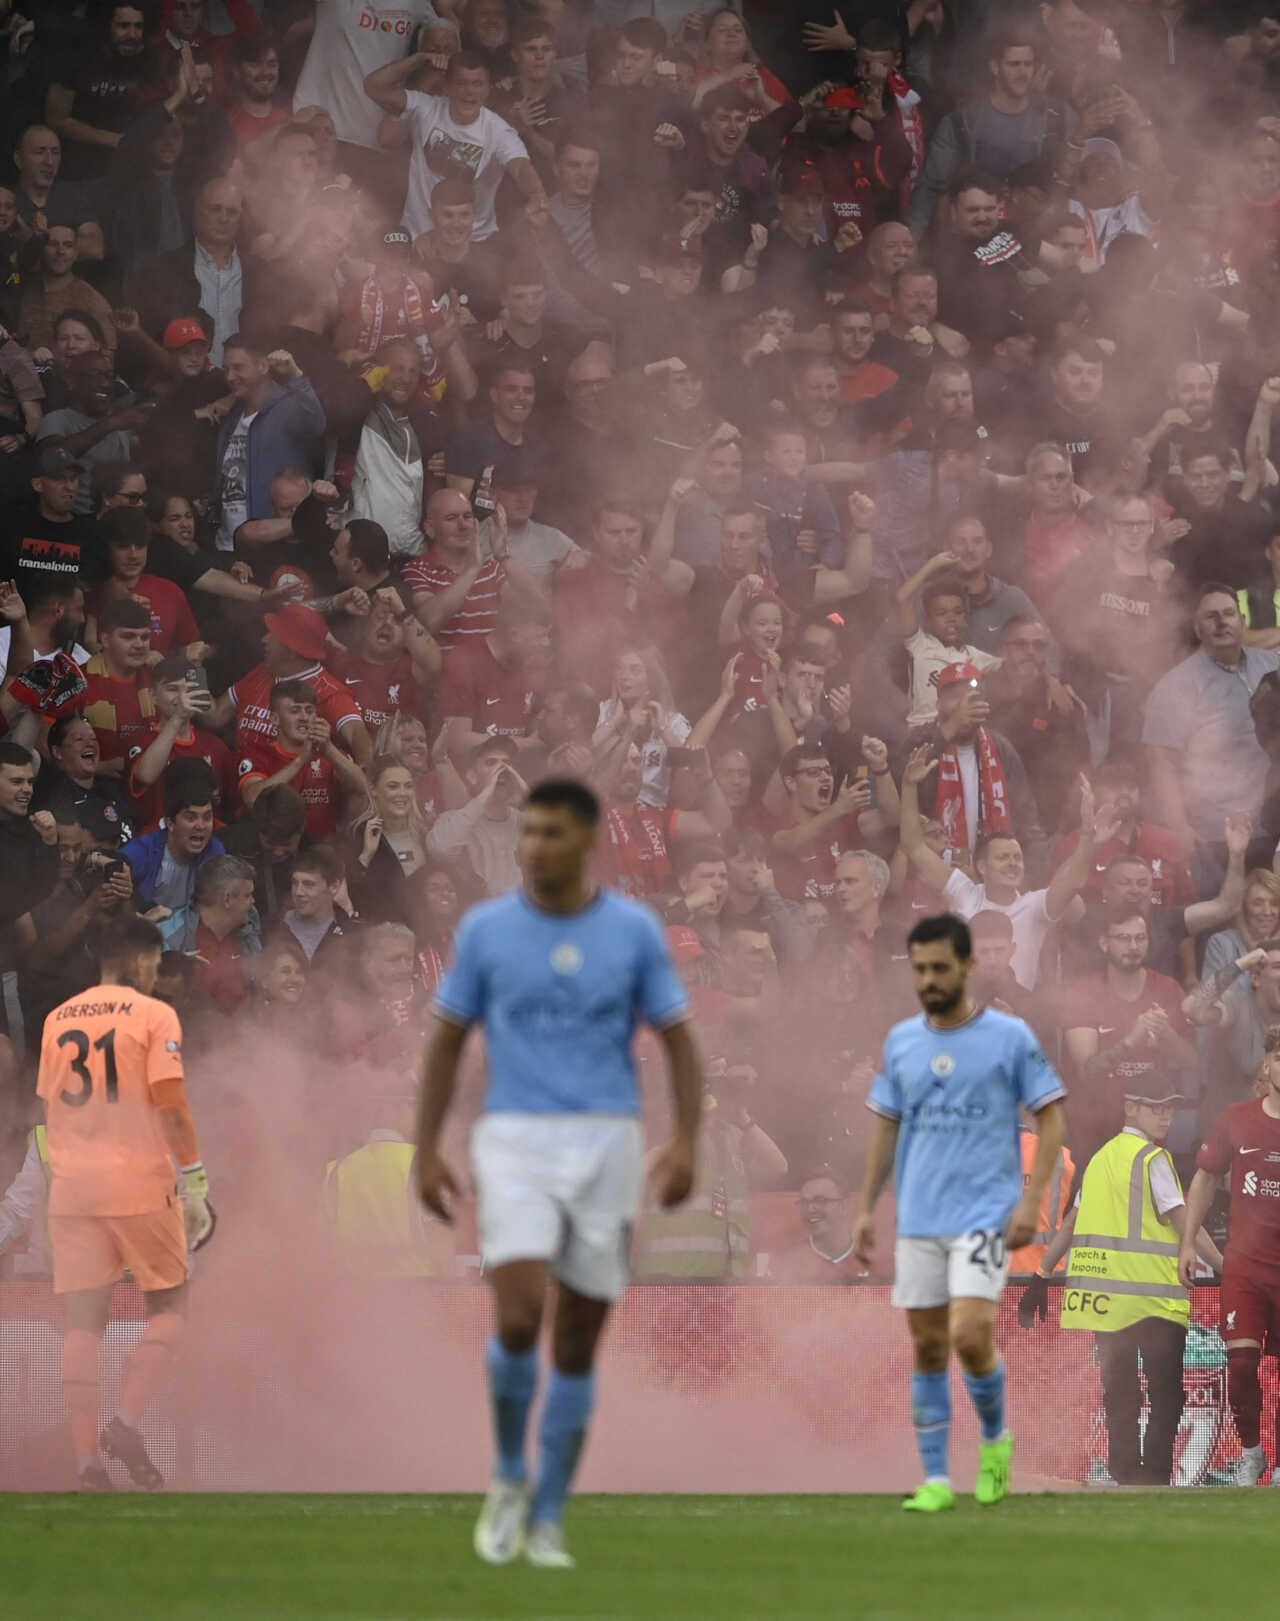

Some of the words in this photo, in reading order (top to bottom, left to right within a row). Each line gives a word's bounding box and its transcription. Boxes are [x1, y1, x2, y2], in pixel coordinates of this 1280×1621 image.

[18, 557, 80, 573] transalpino
[56, 1002, 118, 1021] EDERSON
[56, 1028, 118, 1107] 31
[968, 1230, 1005, 1269] 20
